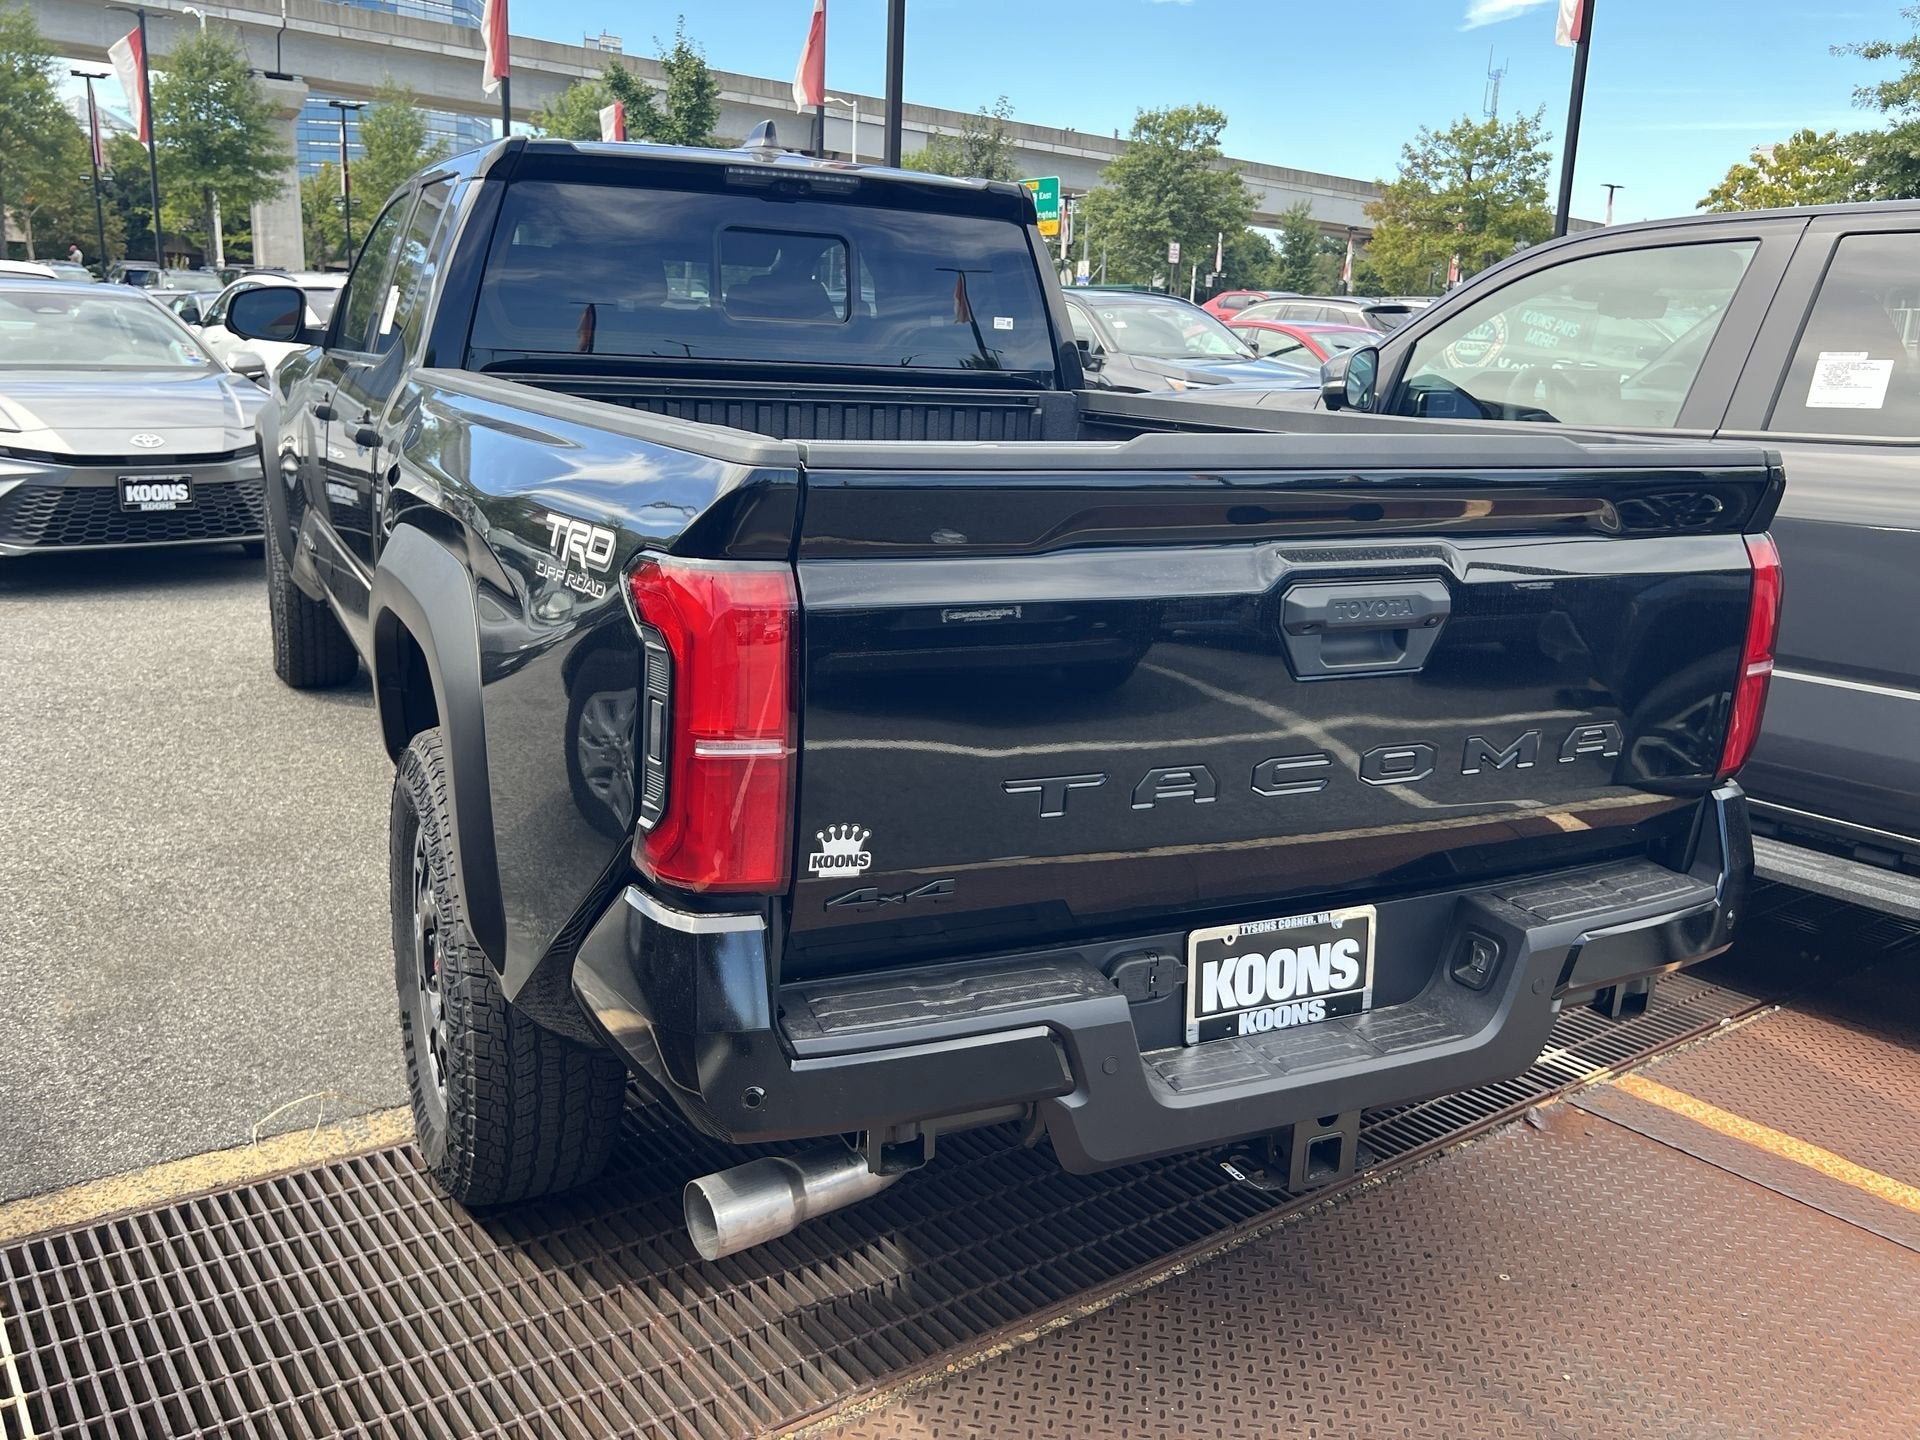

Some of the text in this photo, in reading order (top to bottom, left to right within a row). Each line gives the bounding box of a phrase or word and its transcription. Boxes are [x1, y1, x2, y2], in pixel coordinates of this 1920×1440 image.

[125, 484, 189, 502] KOONS
[545, 511, 617, 573] TRD
[535, 560, 607, 599] OFF ROAD
[1335, 599, 1414, 619] TOYOTA
[1001, 720, 1625, 820] TACOMA
[811, 853, 869, 869] KOONS
[1241, 921, 1277, 935] TYSONS
[1317, 912, 1331, 924] VA
[1202, 938, 1360, 1013] KOONS
[1238, 999, 1326, 1036] KOONS
